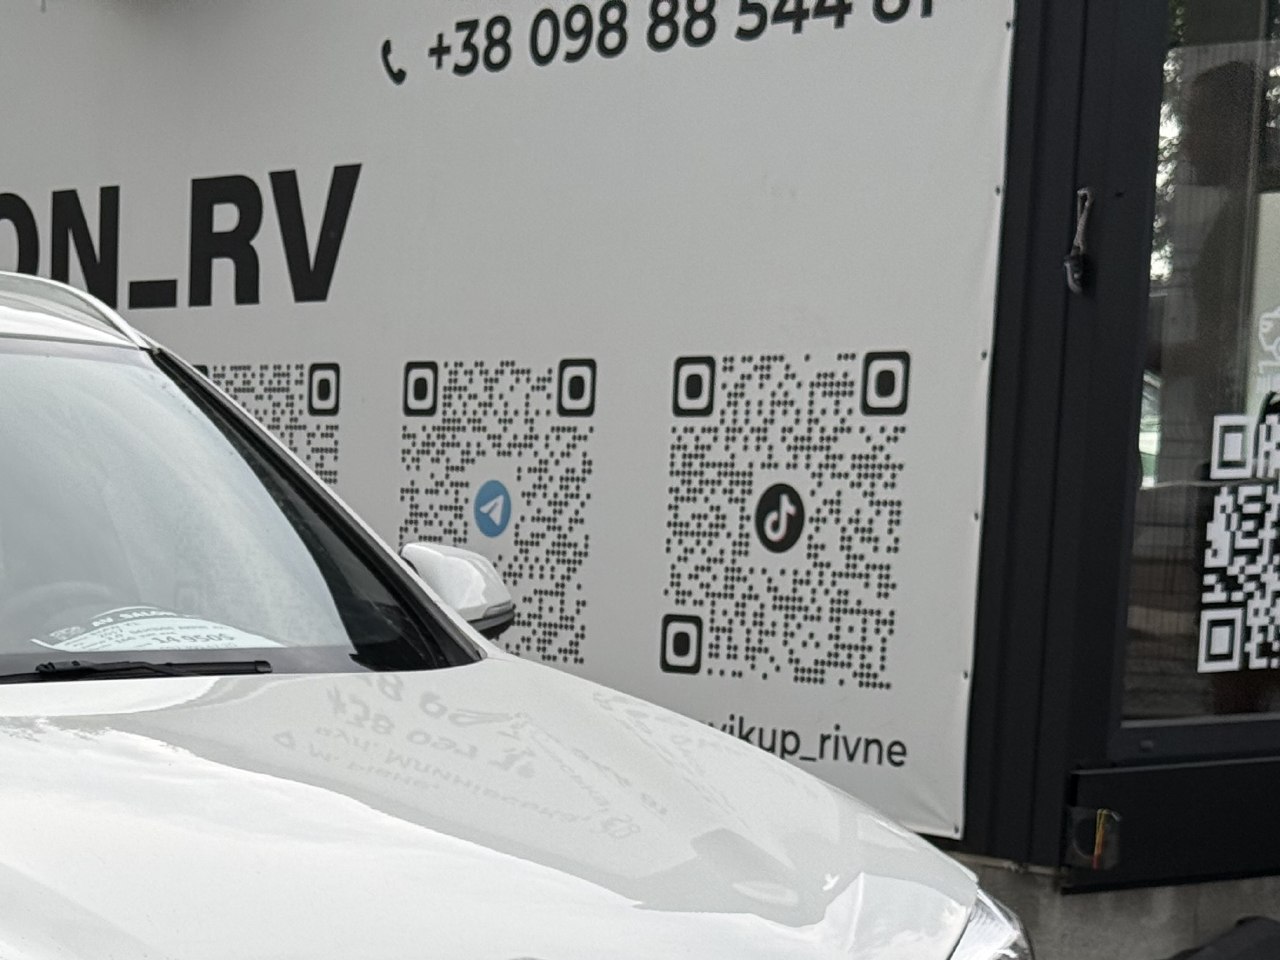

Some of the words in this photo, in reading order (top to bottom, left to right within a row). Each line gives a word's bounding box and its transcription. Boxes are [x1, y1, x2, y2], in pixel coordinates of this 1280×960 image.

[427, 15, 513, 76] +38
[529, 0, 628, 66] 098
[646, 0, 717, 52] 88
